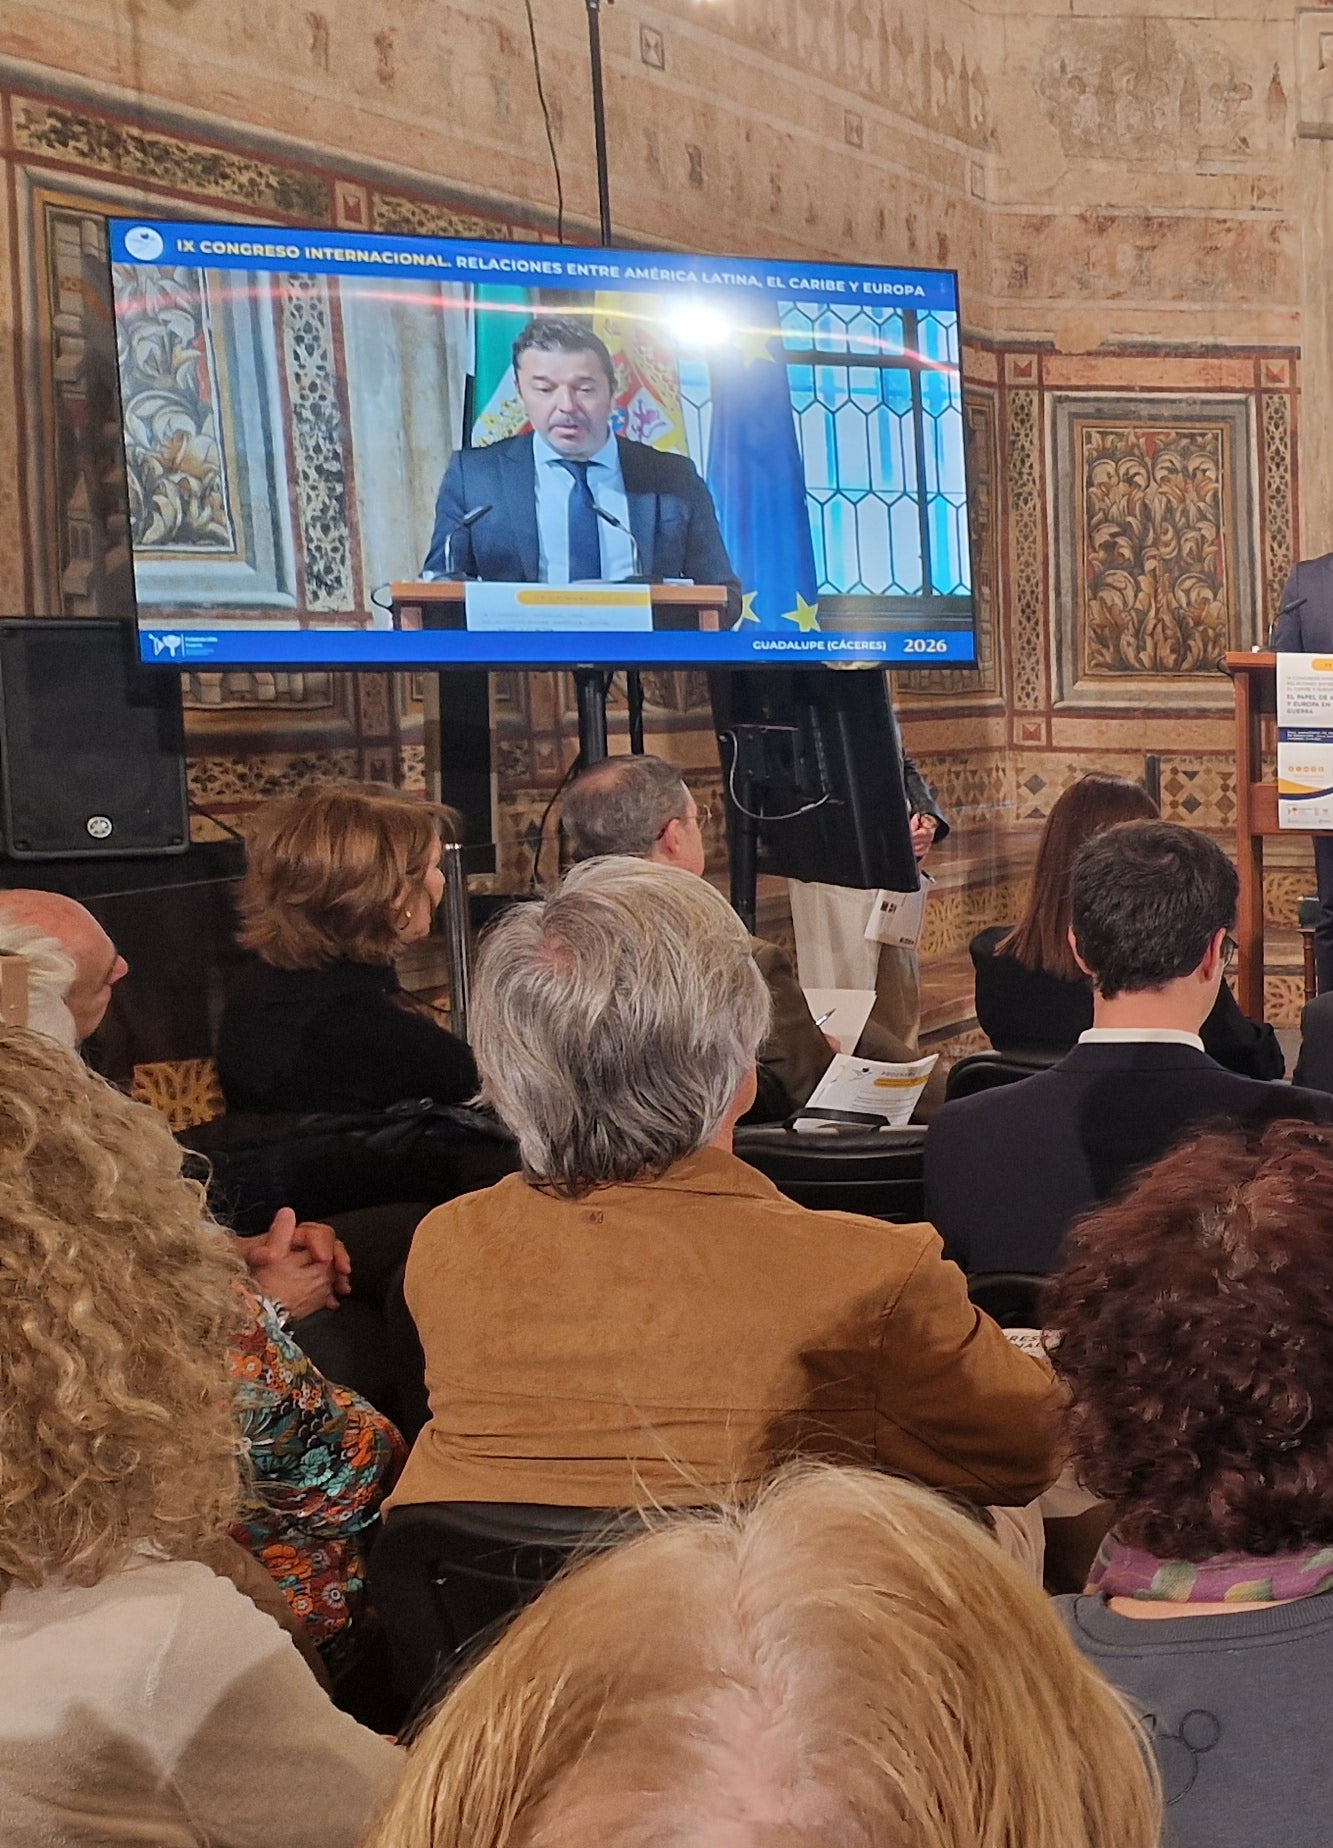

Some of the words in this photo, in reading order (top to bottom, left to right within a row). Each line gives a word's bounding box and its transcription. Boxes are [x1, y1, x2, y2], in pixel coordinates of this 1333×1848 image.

[177, 239, 195, 252] IX
[200, 240, 300, 259] CONGRESO
[305, 246, 452, 268] INTERNACIONAL.
[456, 256, 562, 275] RELACIONES
[567, 263, 619, 278] ENTRE
[624, 265, 698, 282] AMÉRICA
[702, 271, 762, 288] LATINA,
[767, 276, 785, 289] EL
[789, 277, 845, 292] CARIBE
[850, 281, 860, 293] Y
[863, 283, 925, 297] EUROPA
[752, 640, 825, 651] GUADALUPE
[827, 639, 887, 652] (CÁCERES)
[903, 638, 947, 653] 2026
